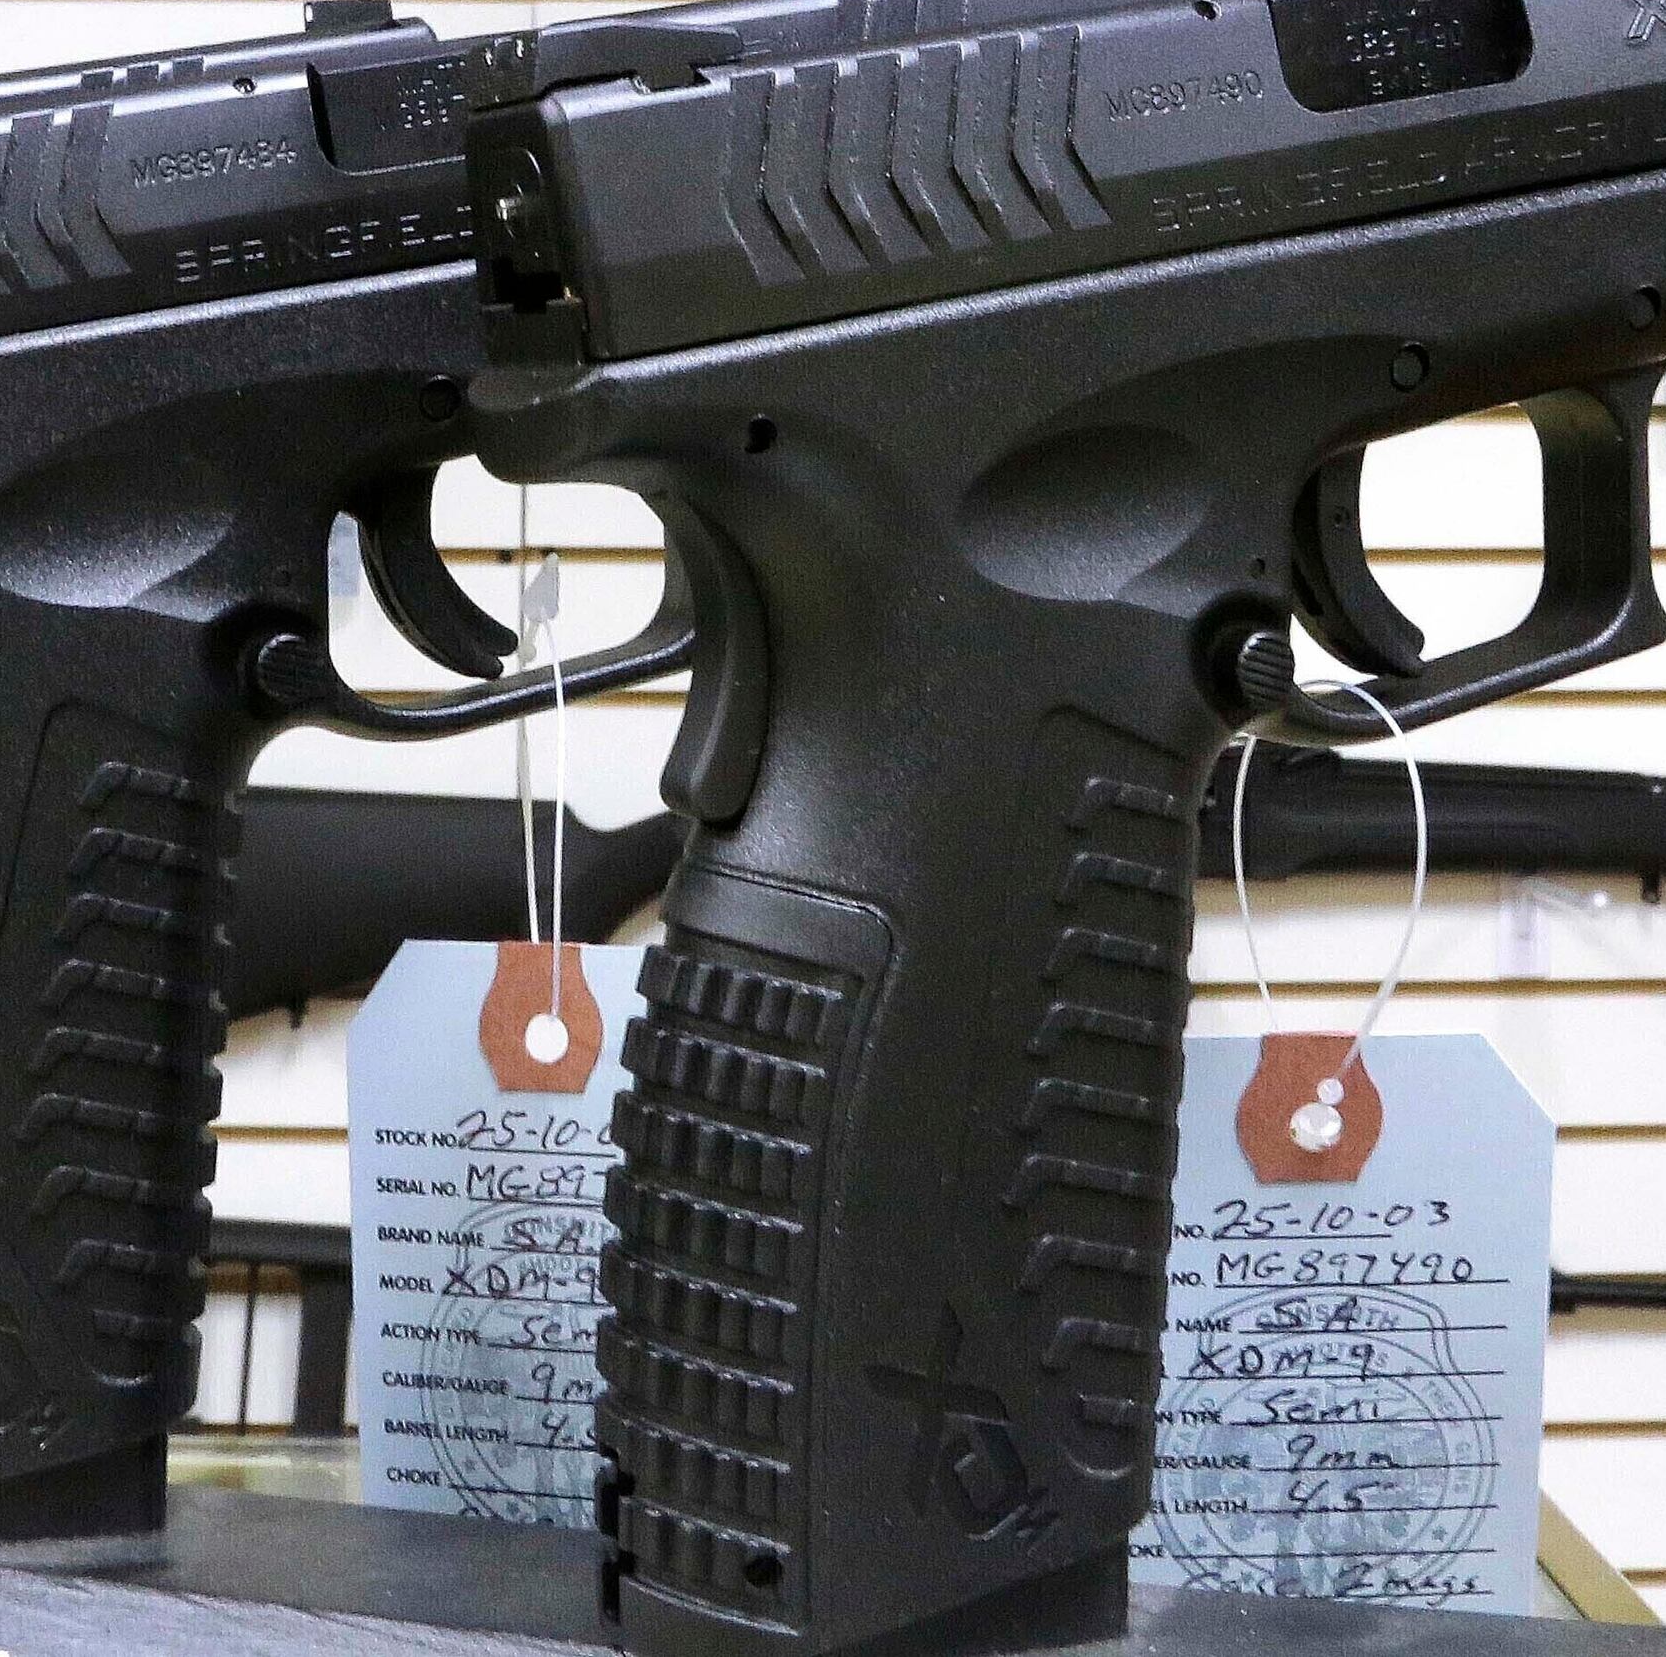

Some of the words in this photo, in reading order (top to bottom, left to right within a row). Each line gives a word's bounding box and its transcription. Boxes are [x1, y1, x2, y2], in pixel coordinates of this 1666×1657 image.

[375, 1127, 427, 1146] STOCK
[376, 1176, 424, 1196] SERIAL
[1214, 1199, 1451, 1239] 25-10-03
[377, 1226, 432, 1244] BRAND
[437, 1230, 485, 1247] NAME
[379, 1273, 435, 1293] MODEL
[381, 1323, 440, 1342] ACTION
[446, 1327, 482, 1343] TYPE
[1175, 1316, 1232, 1334] NAME
[1178, 1409, 1222, 1425] TYPE
[384, 1418, 443, 1441] BARREL
[446, 1423, 509, 1443] LENGTH
[1156, 1453, 1251, 1470] ER/GAUGE
[386, 1467, 442, 1487] CHOKE
[1174, 1499, 1249, 1515] LENGTH
[1129, 1545, 1165, 1559] OKE
